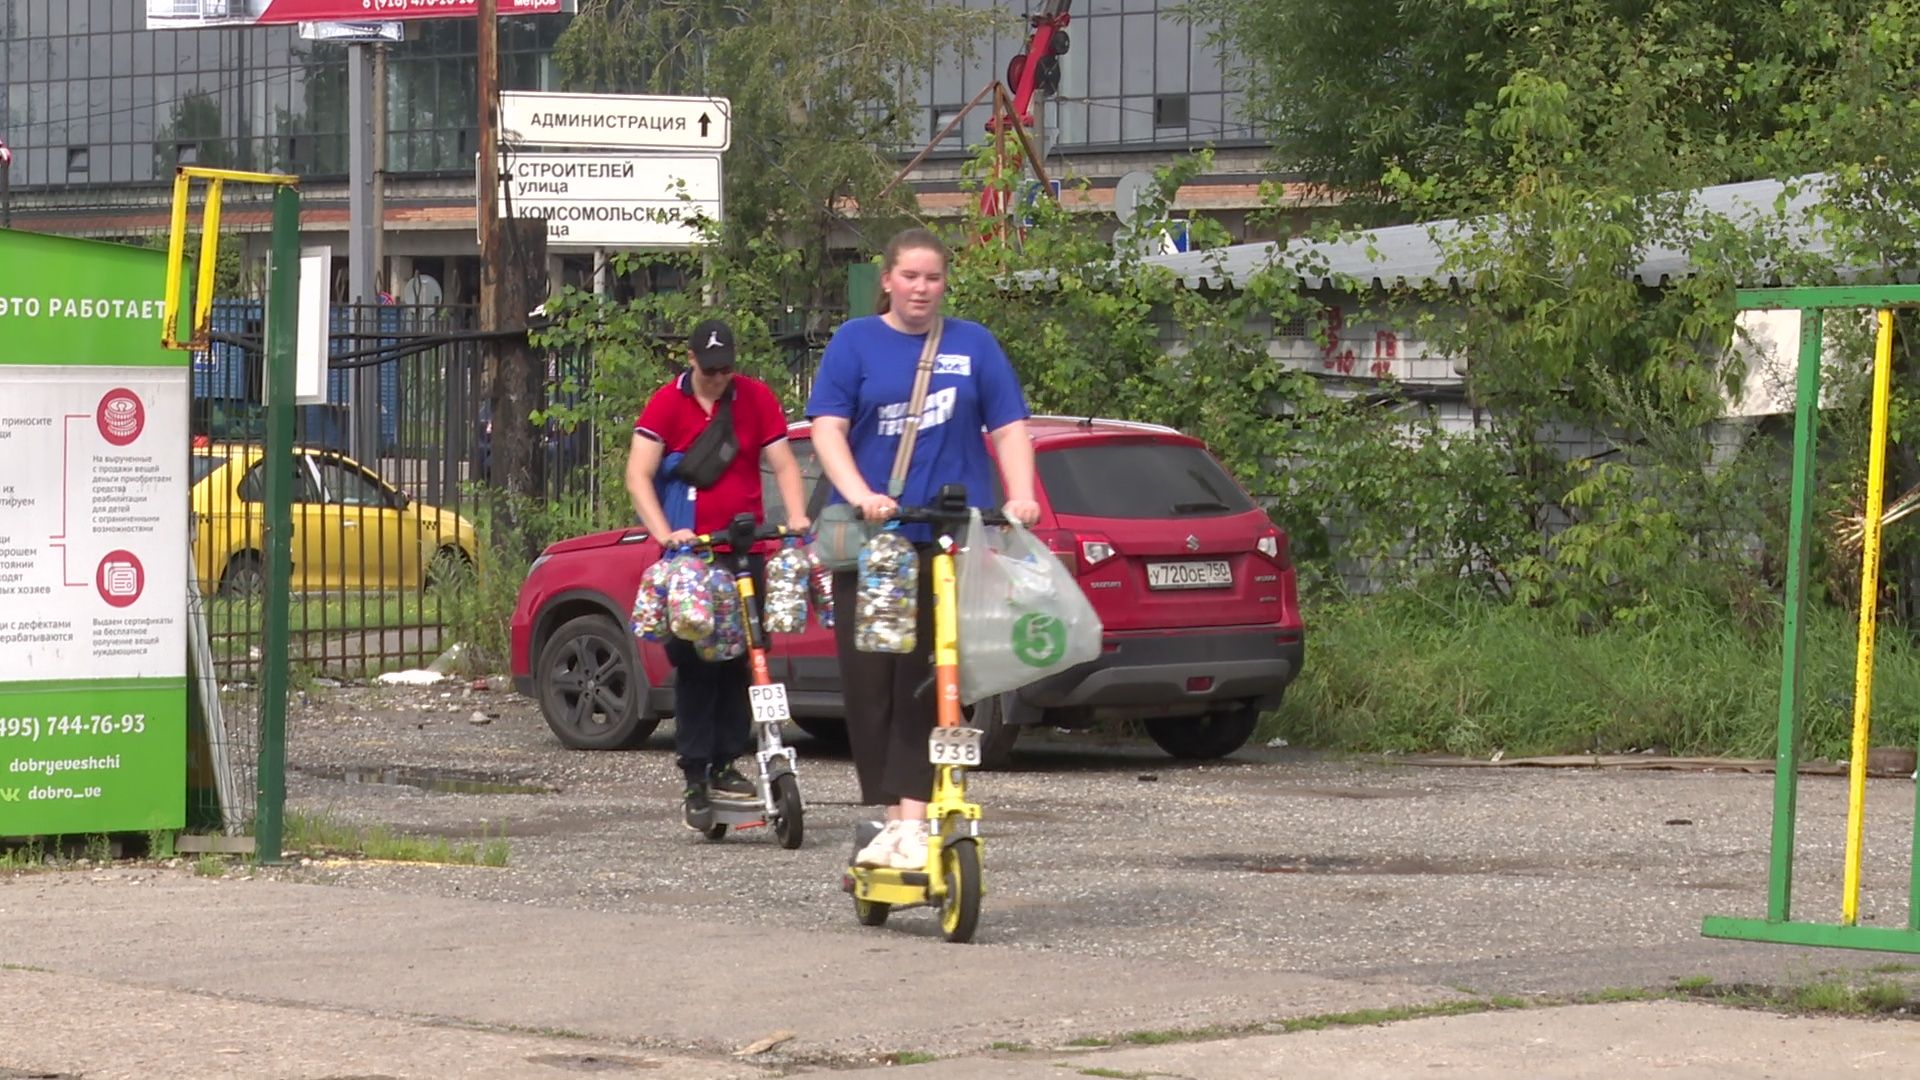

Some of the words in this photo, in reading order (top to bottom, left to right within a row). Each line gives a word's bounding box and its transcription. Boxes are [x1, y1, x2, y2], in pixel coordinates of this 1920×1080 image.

[530, 112, 687, 131] АДМИНИСТРАЦИЯ
[518, 160, 634, 178] СТРОИТЕЛЕЙ
[518, 182, 569, 196] улица
[519, 206, 681, 222] КОМСОМОЛЬСКАЯ
[49, 298, 166, 319] РАБОТАЕТ
[2, 417, 53, 428] приносите
[0, 574, 23, 583] одят
[17, 586, 51, 594] хозяев
[18, 620, 72, 631] дефектами
[752, 686, 783, 701] PD3
[756, 704, 787, 718] 705
[47, 714, 145, 736] 744-76-93
[934, 742, 976, 761] 938
[9, 754, 121, 775] dobryeveshchi
[28, 785, 102, 800] dobro_ve
